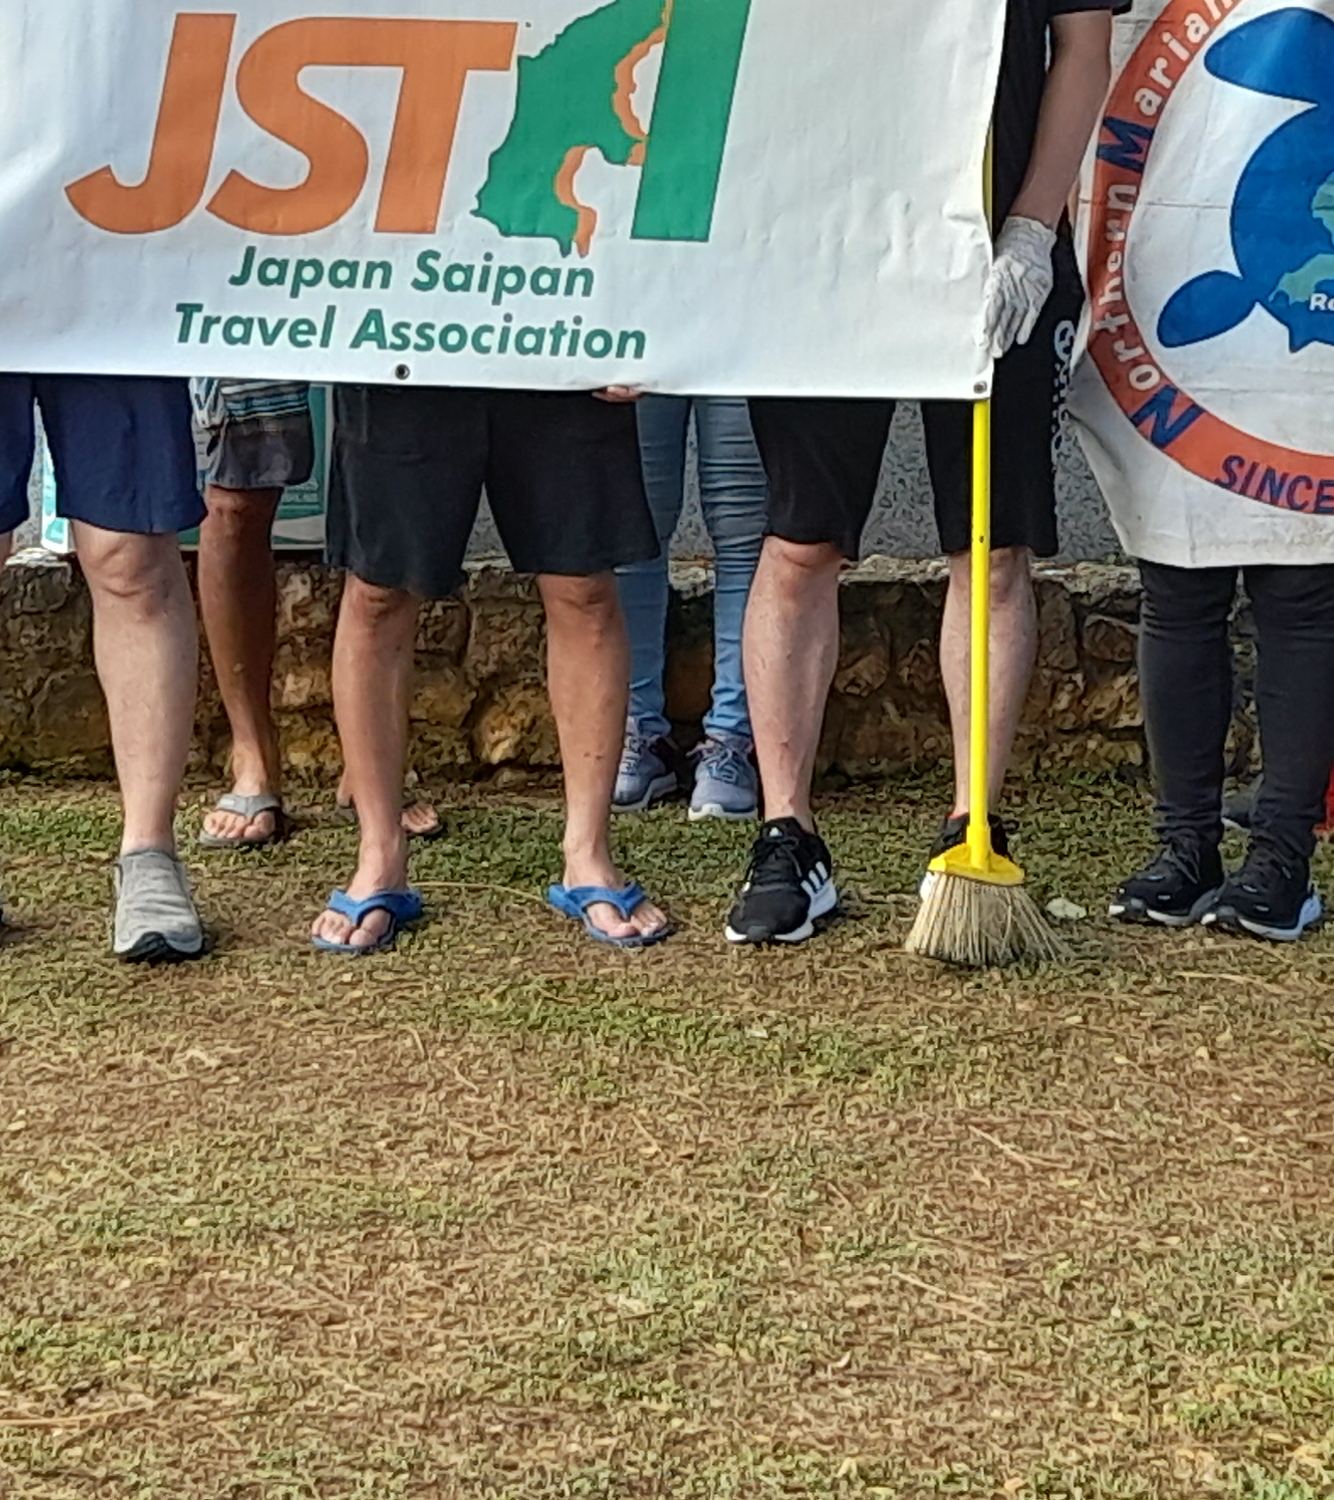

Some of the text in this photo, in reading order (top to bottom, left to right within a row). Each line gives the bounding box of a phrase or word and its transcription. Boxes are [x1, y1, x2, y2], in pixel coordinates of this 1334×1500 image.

[228, 247, 596, 306] Japan Saipan
[175, 302, 647, 361] Travel Association
[1094, 184, 1208, 450] Northern
